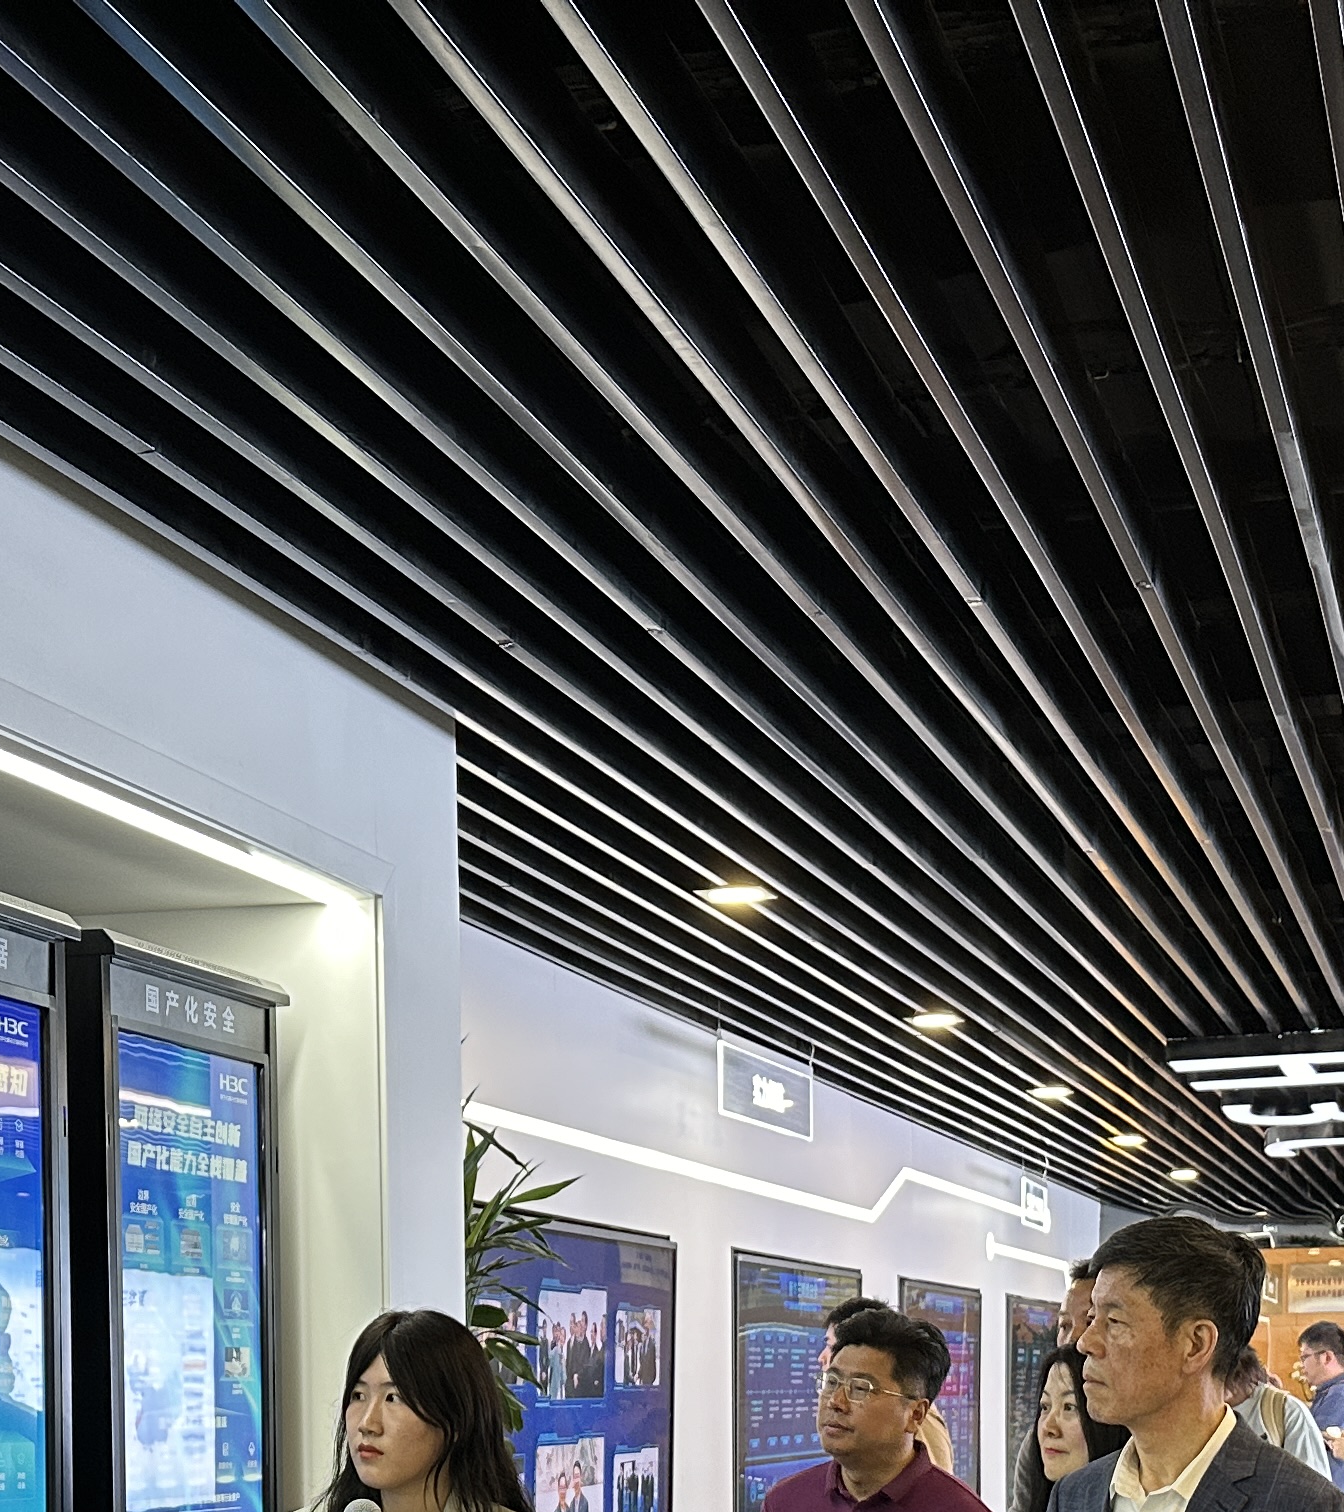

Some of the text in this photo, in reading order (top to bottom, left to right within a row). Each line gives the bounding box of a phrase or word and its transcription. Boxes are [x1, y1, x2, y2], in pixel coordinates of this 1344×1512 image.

[145, 984, 235, 1034] 国产化安全
[219, 1073, 248, 1096] H3C
